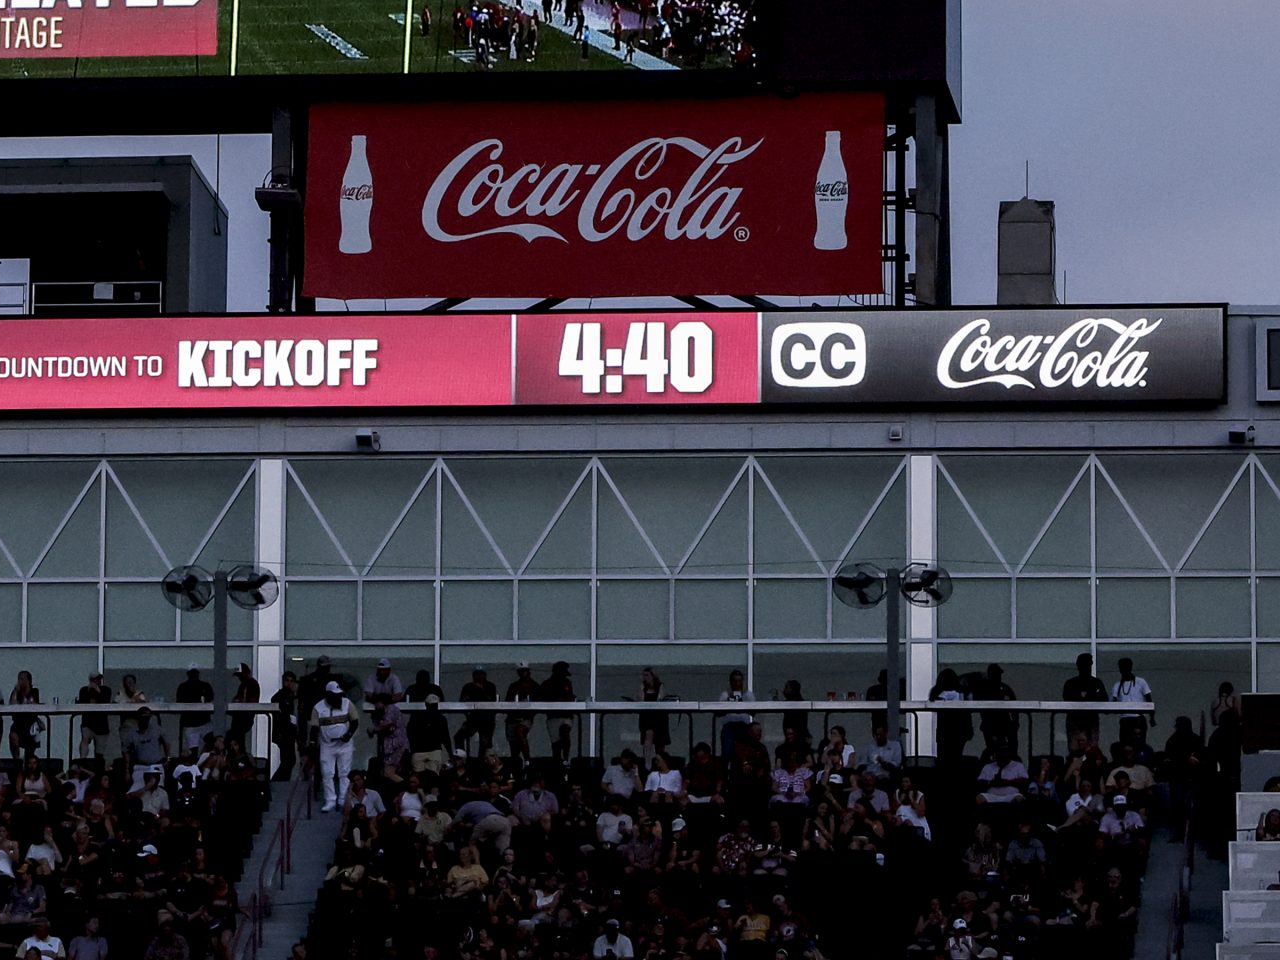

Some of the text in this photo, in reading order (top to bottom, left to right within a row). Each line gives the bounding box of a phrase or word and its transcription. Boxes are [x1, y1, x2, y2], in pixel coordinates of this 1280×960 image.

[422, 136, 764, 244] Coca-Cola
[133, 355, 163, 377] TO
[178, 339, 378, 387] KICKOFF
[558, 321, 713, 393] 4:40
[780, 332, 856, 380] CC
[936, 318, 1163, 389] Coca-Cola
